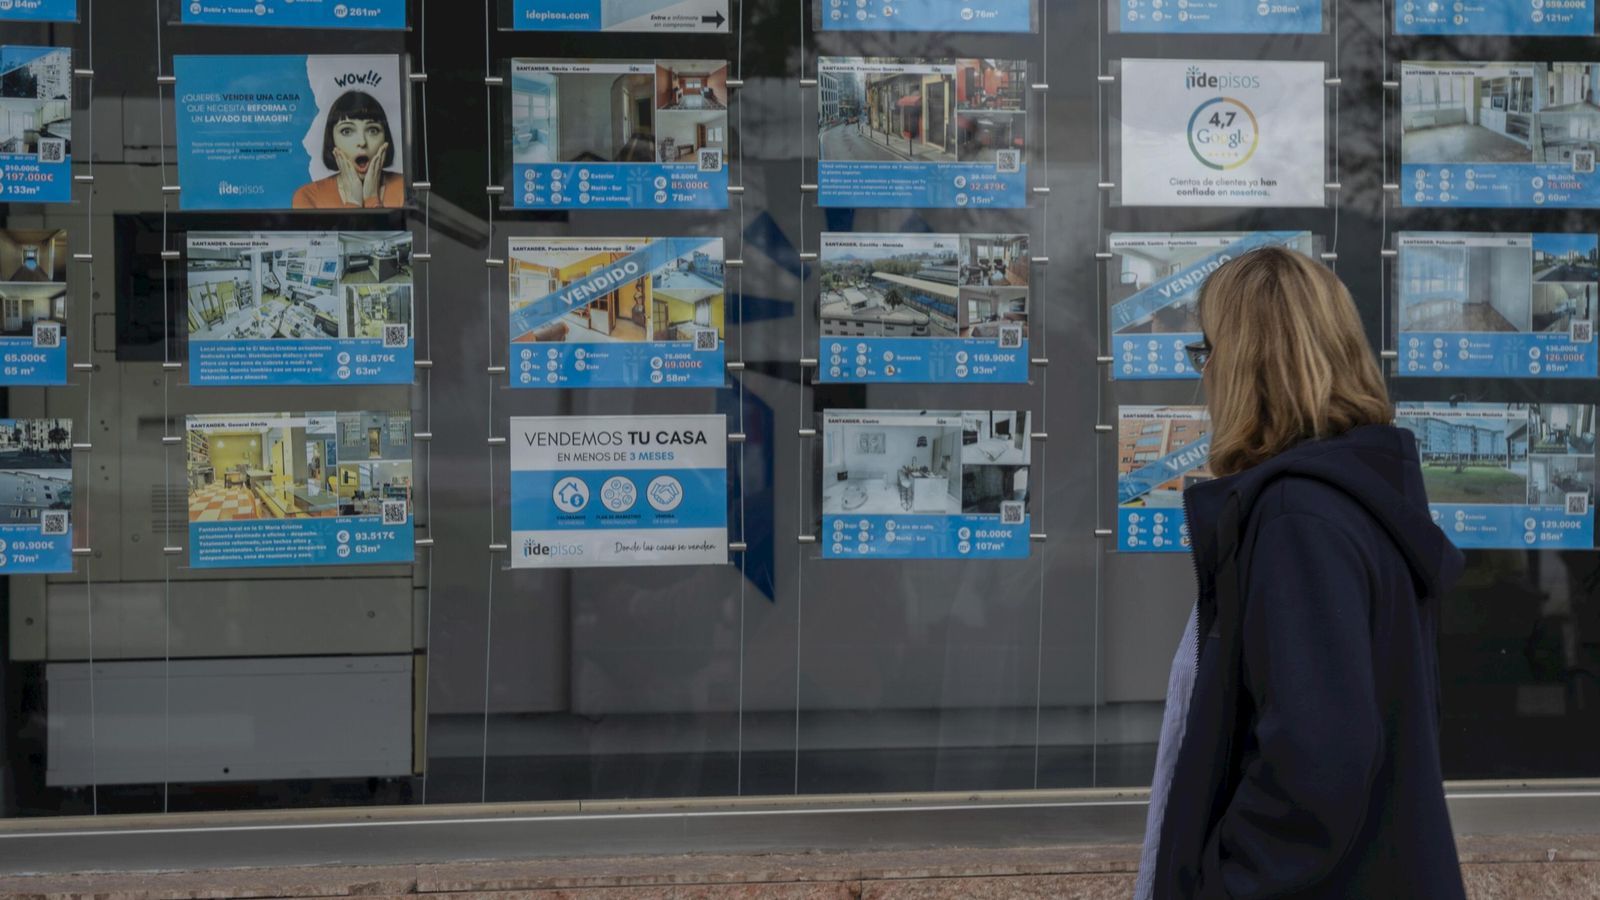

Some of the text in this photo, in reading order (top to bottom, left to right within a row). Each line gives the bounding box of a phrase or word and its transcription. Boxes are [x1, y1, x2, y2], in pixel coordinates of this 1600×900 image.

[350, 7, 381, 16] 261m²
[526, 10, 590, 21] idepisos.com
[1546, 14, 1574, 22] 121m²
[334, 70, 382, 88] WOW!!!
[1185, 72, 1260, 92] idepisos
[182, 93, 221, 103] ¿QUIERES
[187, 103, 297, 112] QUE NECESITA REFORMA O
[191, 114, 292, 123] UN LAVADO DE IMAGEN?
[1208, 112, 1237, 129] 4,7
[1197, 128, 1249, 149] Google
[5, 172, 54, 182] 197.000€
[1169, 176, 1278, 188] Cientos de clientes ya han
[7, 185, 40, 194] 133m²
[1176, 187, 1216, 196] confiado
[559, 261, 639, 306] VENDIDO
[4, 354, 47, 362] 65.000€
[355, 354, 395, 362] 68.876€
[973, 354, 1016, 362] 169.900€
[664, 360, 704, 369] 69.000€
[4, 366, 35, 375] 65 m²
[355, 367, 381, 376] 63m²
[972, 366, 997, 375] 93m²
[525, 430, 708, 447] VENDEMOS TU CASA
[557, 451, 675, 462] EN MENOS DE 3 MESES
[1541, 520, 1581, 529] 129.000€
[355, 531, 395, 541] 93.517€
[975, 530, 1013, 538] 80.000€
[12, 541, 55, 550] 69.900€
[355, 544, 381, 553] 63m²
[523, 542, 584, 558] idepisos
[614, 540, 642, 554] Donde
[642, 540, 654, 552] las
[677, 543, 688, 551] se
[688, 540, 716, 552] venden
[975, 542, 1005, 550] 107m²
[12, 554, 40, 563] 70m²
